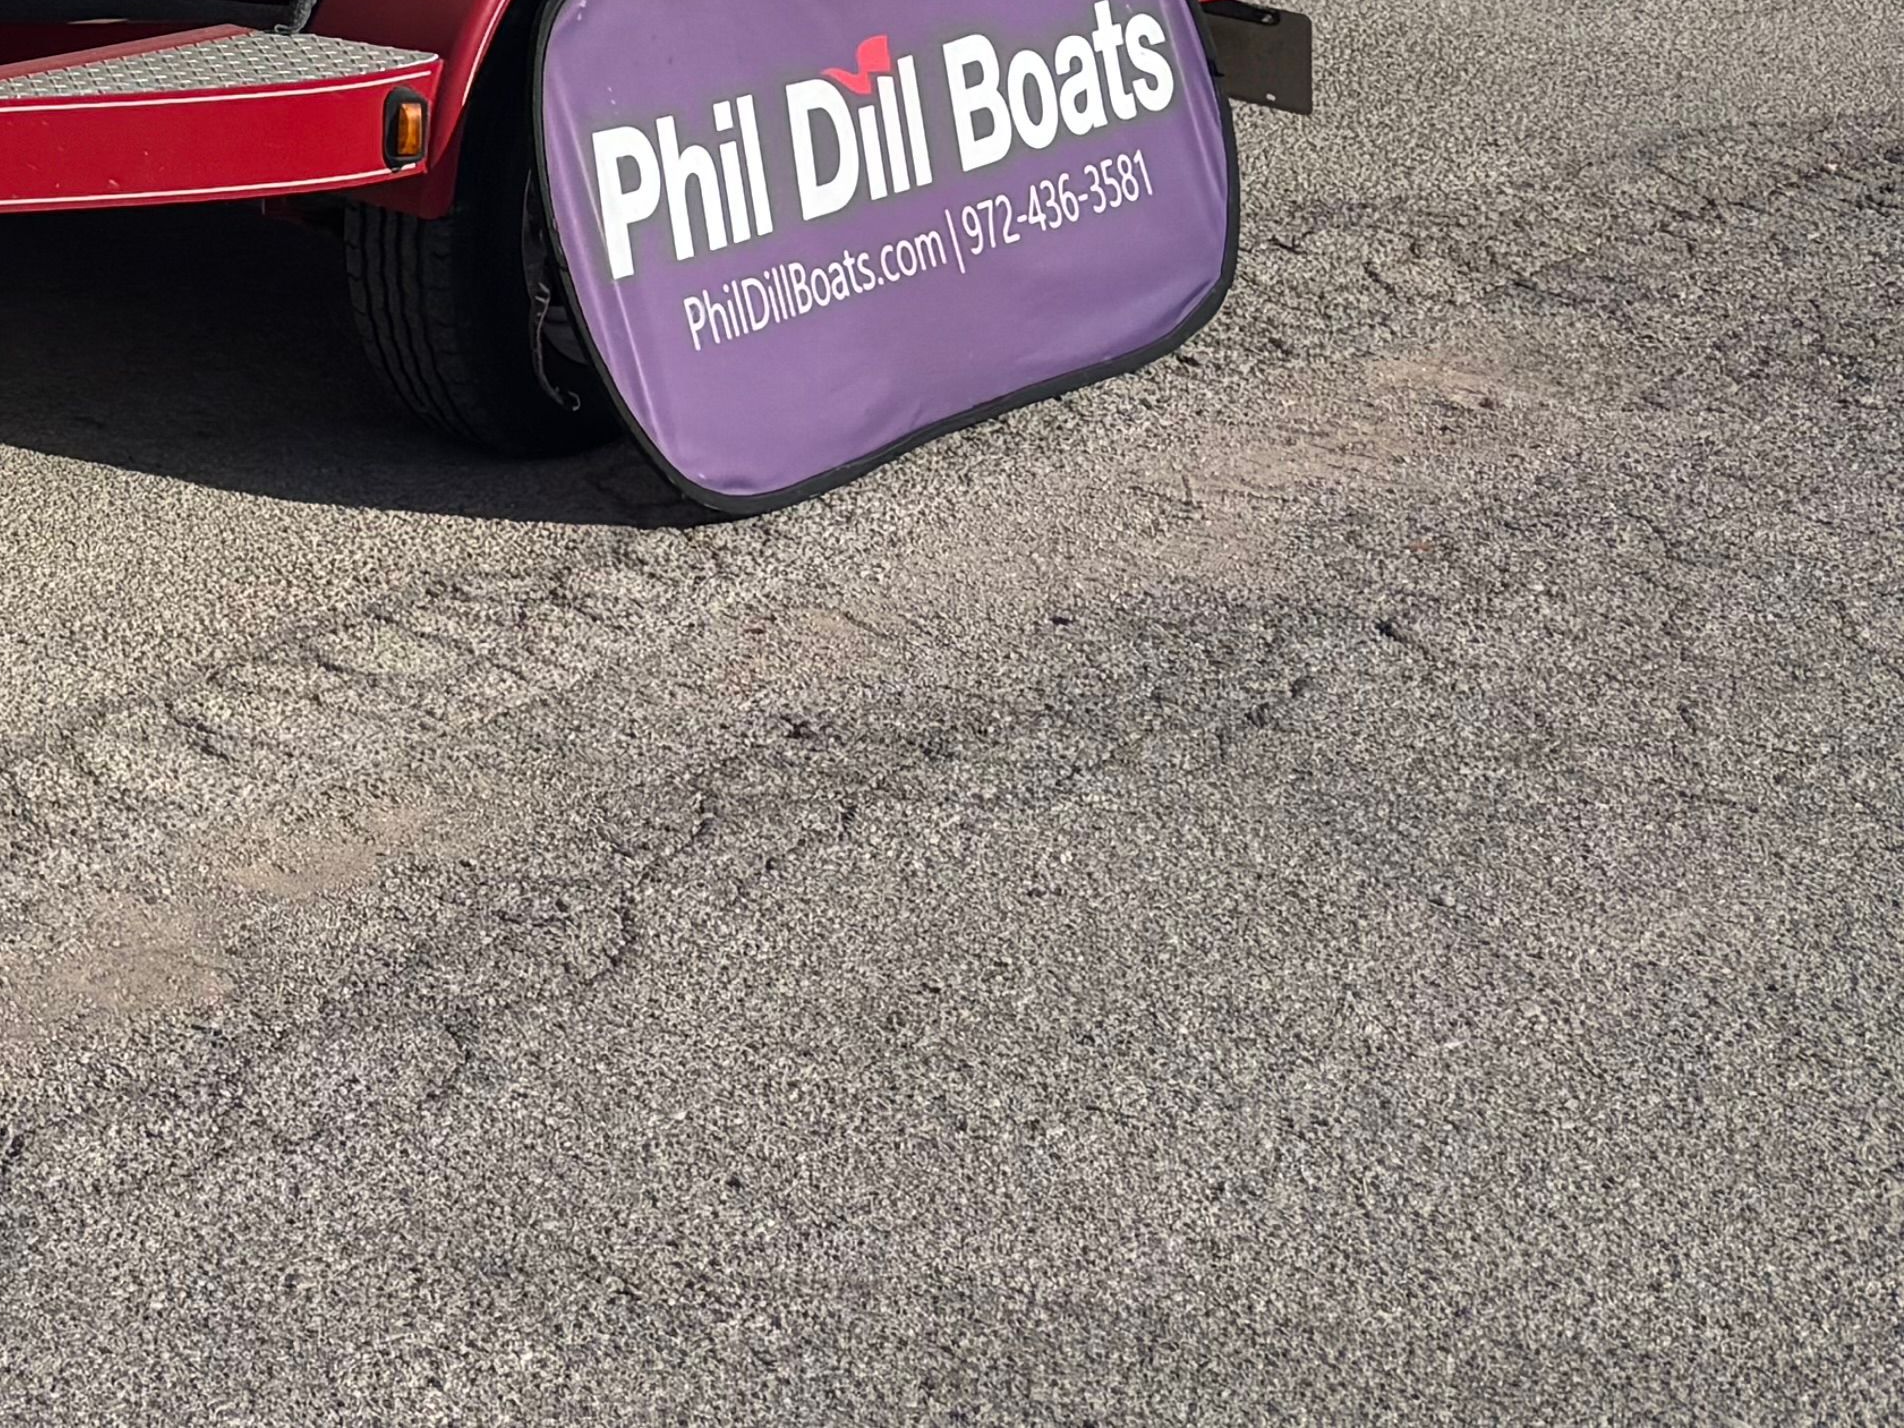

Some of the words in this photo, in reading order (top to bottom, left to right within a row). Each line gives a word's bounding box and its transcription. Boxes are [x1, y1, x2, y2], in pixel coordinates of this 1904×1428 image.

[592, 93, 773, 281] Phil
[785, 55, 933, 222] Dill
[683, 228, 946, 352] PhilDillBoats.com
[961, 149, 1154, 258] 972-436-3581
